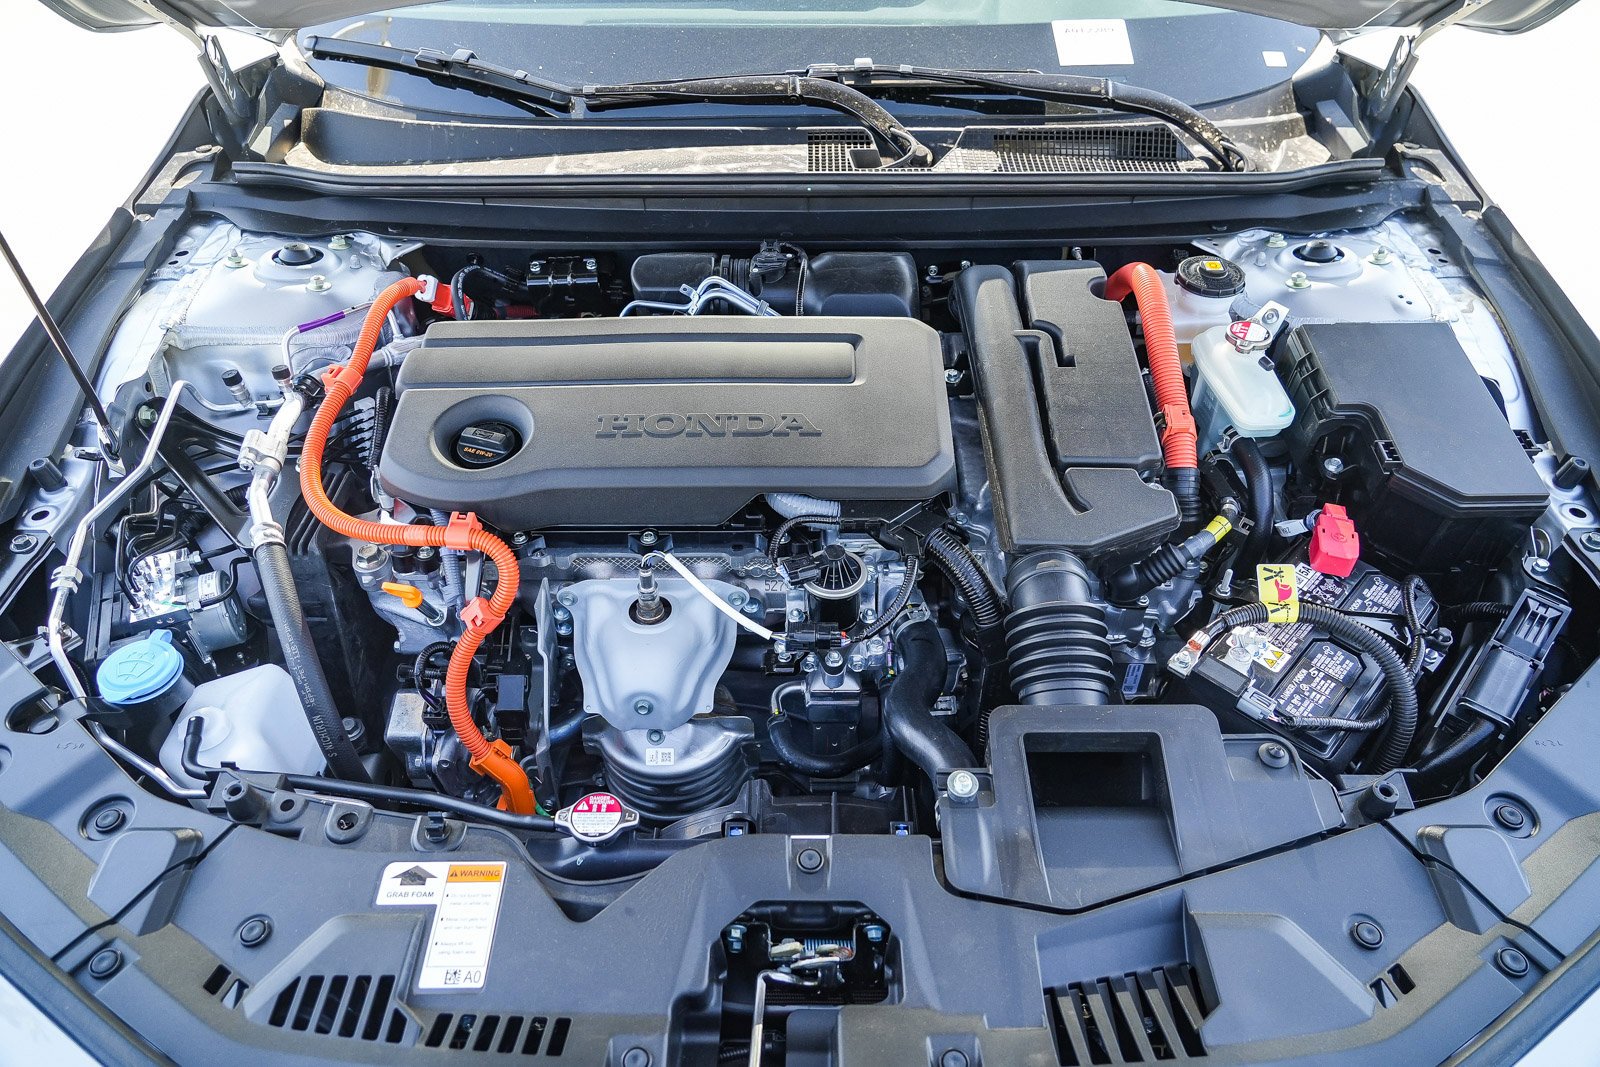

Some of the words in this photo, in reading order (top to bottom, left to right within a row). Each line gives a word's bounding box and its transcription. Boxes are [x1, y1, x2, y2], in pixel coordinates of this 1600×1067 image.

[596, 412, 823, 438] HONDA
[463, 446, 476, 454] SAE
[764, 579, 784, 592] 527
[460, 869, 500, 877] WARNING
